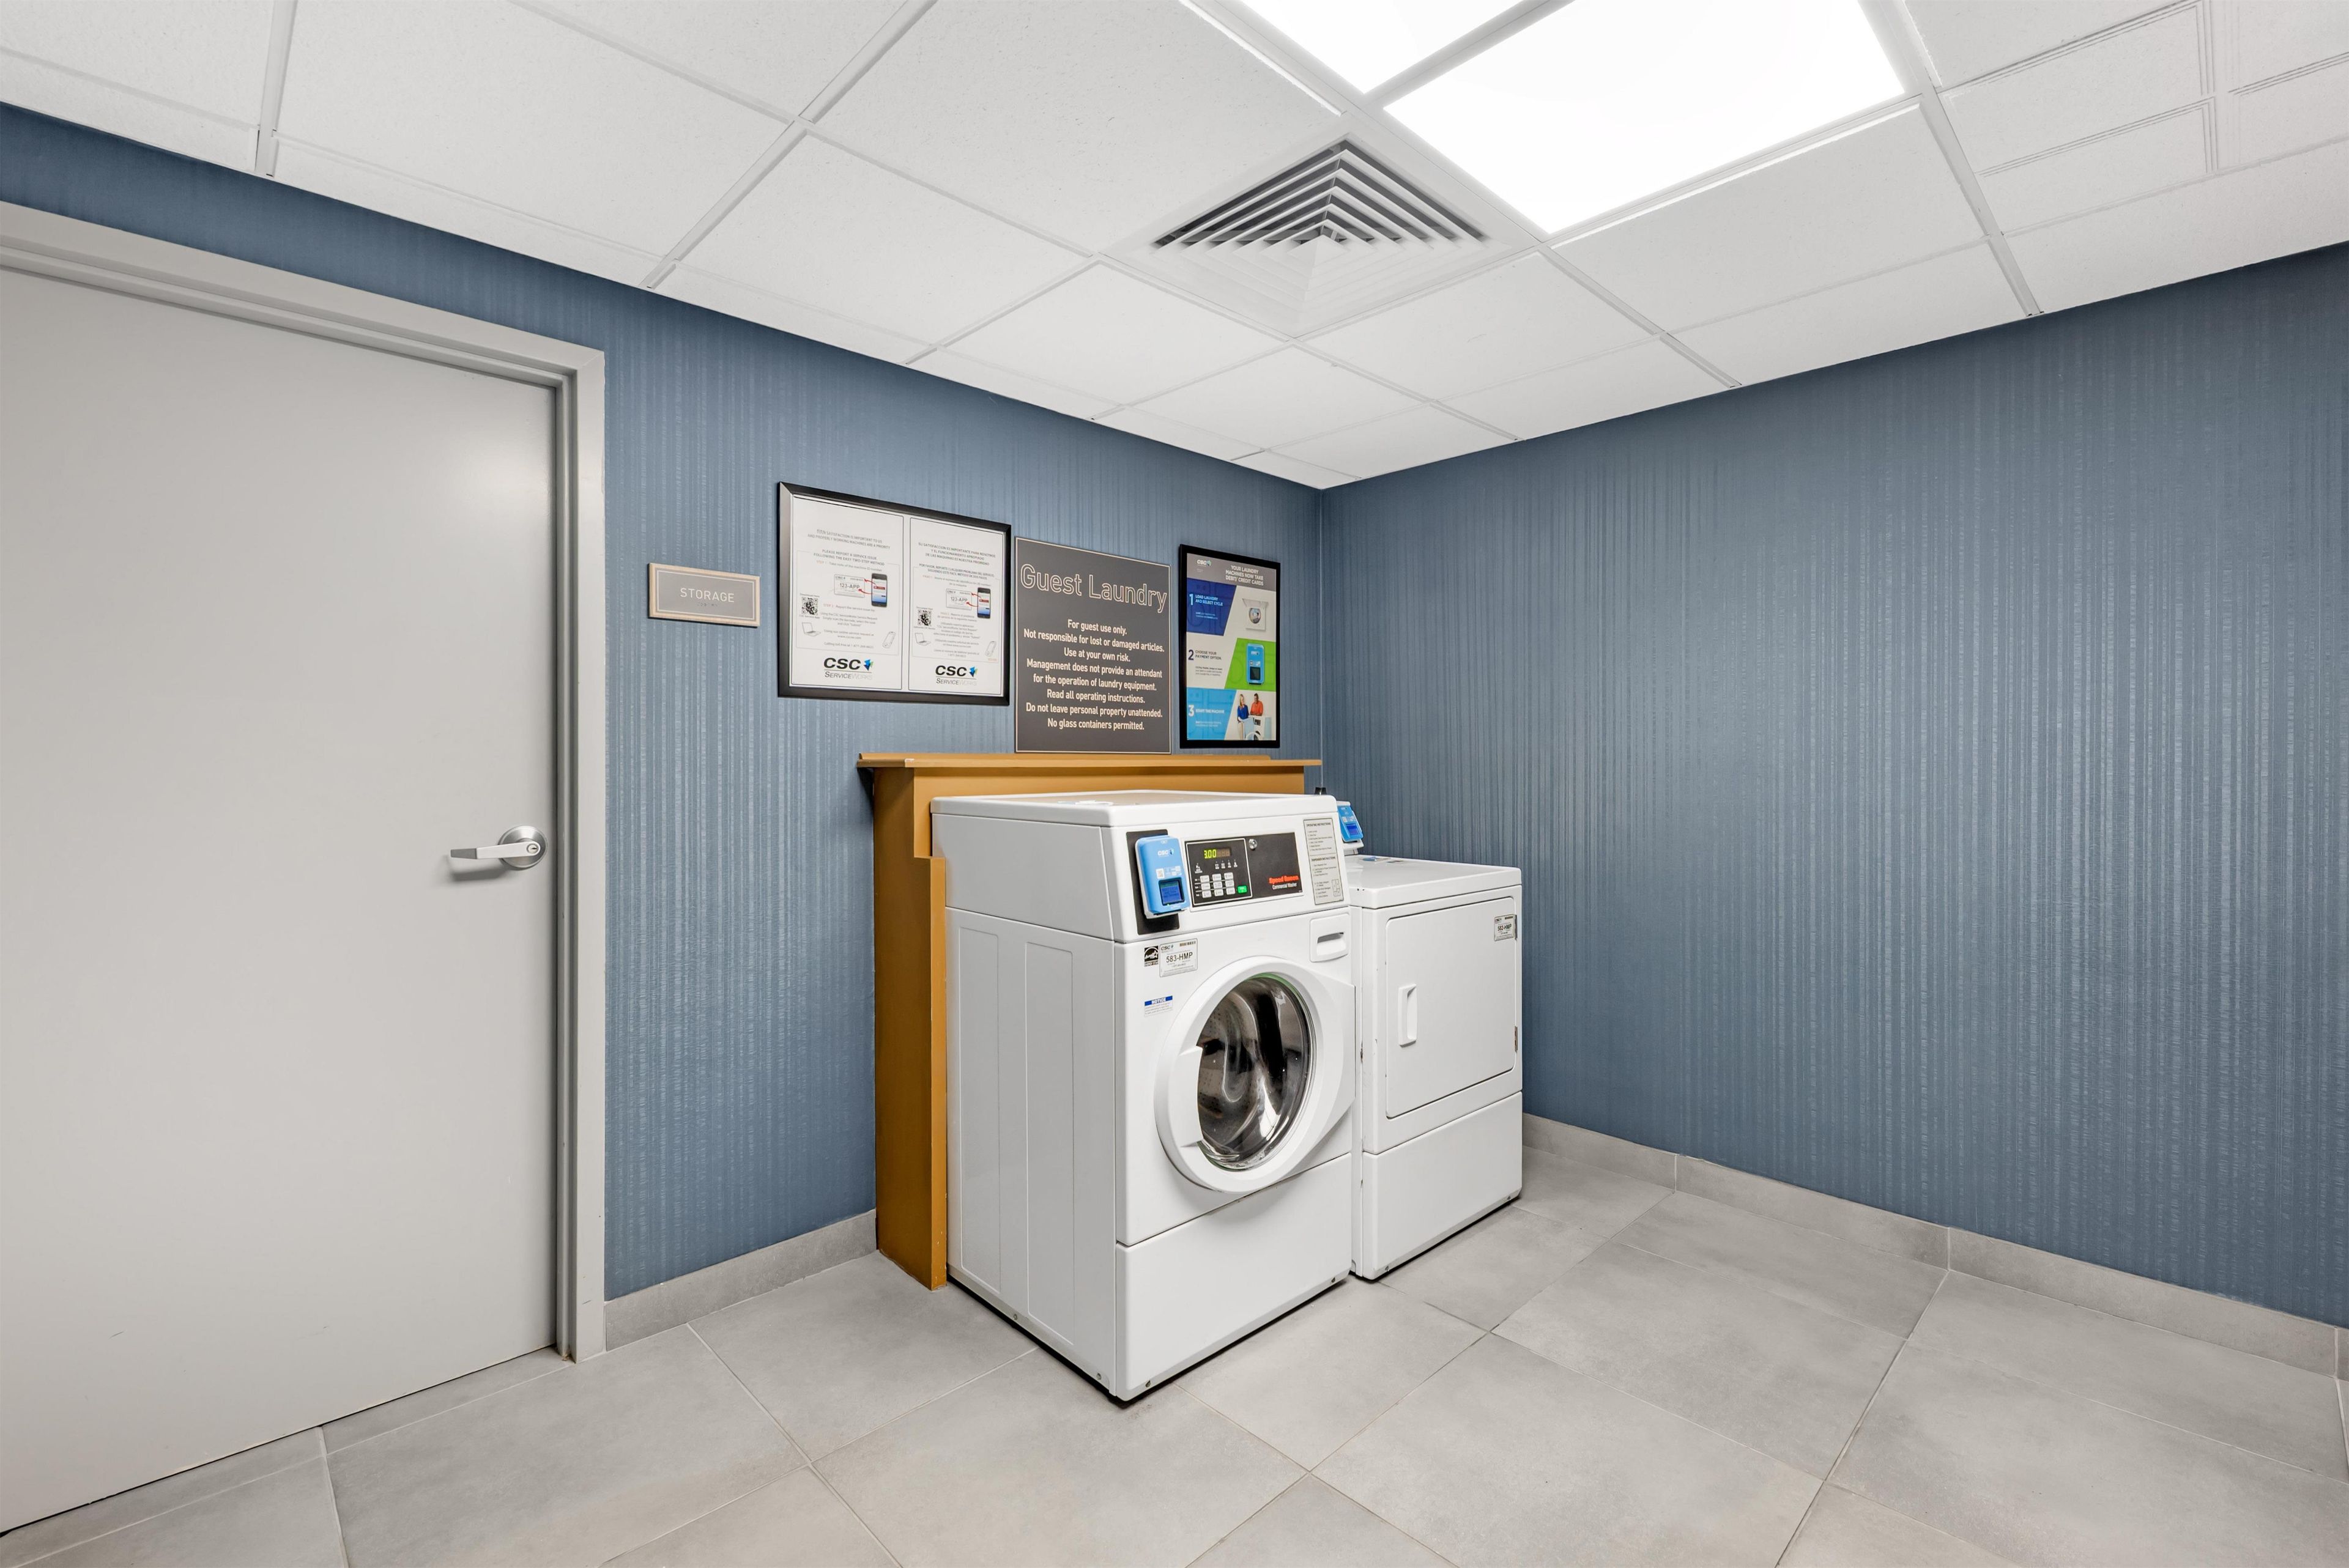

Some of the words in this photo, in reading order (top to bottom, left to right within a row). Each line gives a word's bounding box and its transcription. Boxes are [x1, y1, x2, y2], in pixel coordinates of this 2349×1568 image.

[680, 588, 735, 603] STORAGE
[1020, 564, 1082, 596] Guest
[1089, 575, 1167, 613] Laundry
[1189, 594, 1193, 605] 1
[1067, 619, 1080, 629] For
[1081, 623, 1099, 632] guest
[1113, 626, 1127, 637] only.
[1023, 628, 1036, 638] Not
[1037, 631, 1077, 643] responsible
[1078, 635, 1088, 643] for
[1089, 637, 1102, 645] lost
[1111, 638, 1140, 651] damaged
[1141, 643, 1165, 652] articles.
[1064, 648, 1077, 657] Use
[1086, 652, 1101, 660] your
[1116, 653, 1130, 662] risk.
[1188, 649, 1194, 660] 2
[823, 657, 861, 670] CSC
[935, 665, 967, 676] CSC
[1026, 658, 1071, 671] Management
[1072, 662, 1088, 672] does
[1101, 665, 1124, 675] provide
[1134, 668, 1162, 678] attendant
[1033, 673, 1044, 682] for
[1045, 675, 1056, 684] the
[1058, 677, 1089, 687] operation
[1098, 679, 1123, 690] laundry
[1124, 682, 1157, 692] equipment.
[1047, 689, 1064, 699] Read
[1066, 690, 1074, 699] all
[1075, 692, 1107, 703] operating
[1108, 693, 1145, 703] instructions.
[1026, 702, 1036, 712] Do
[1050, 704, 1068, 713] leave
[1069, 706, 1098, 716] personal
[1099, 708, 1127, 717] property
[1128, 709, 1163, 717] unattended.
[1189, 704, 1195, 716] 3
[1047, 718, 1058, 727] No
[1059, 719, 1077, 729] glass
[1078, 720, 1112, 729] containers
[1113, 721, 1145, 731] permitted.
[1166, 952, 1193, 963] 583-HMP
